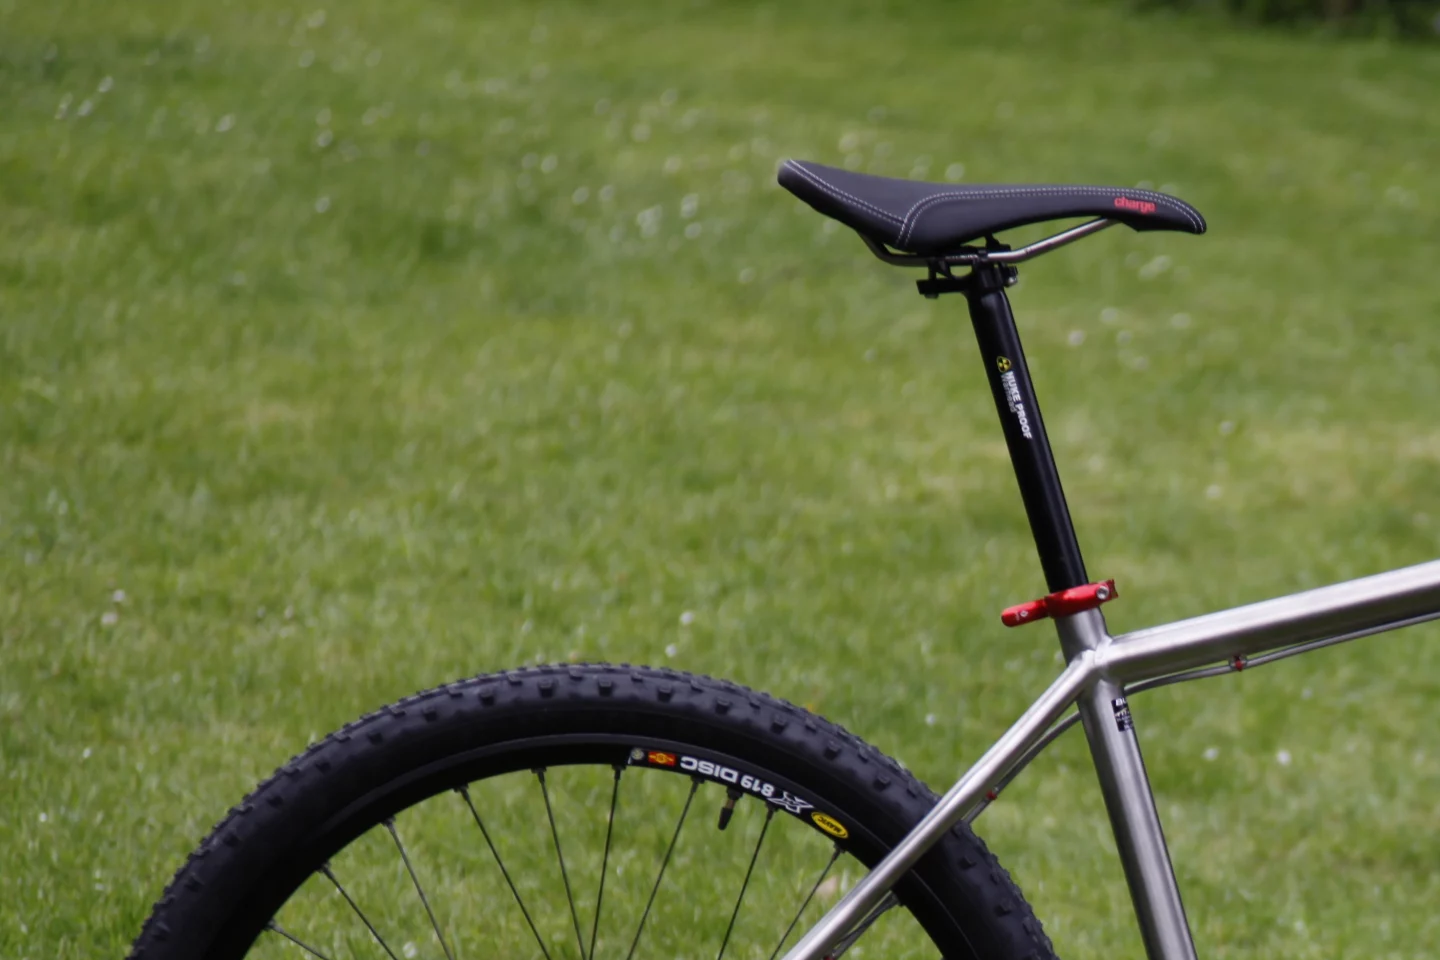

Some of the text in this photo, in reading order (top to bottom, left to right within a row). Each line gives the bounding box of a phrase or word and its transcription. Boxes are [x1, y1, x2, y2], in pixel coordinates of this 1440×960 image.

[1114, 196, 1156, 214] charge
[1004, 370, 1033, 439] NUKE PROOF
[679, 756, 738, 783] DISC
[740, 774, 775, 798] 819
